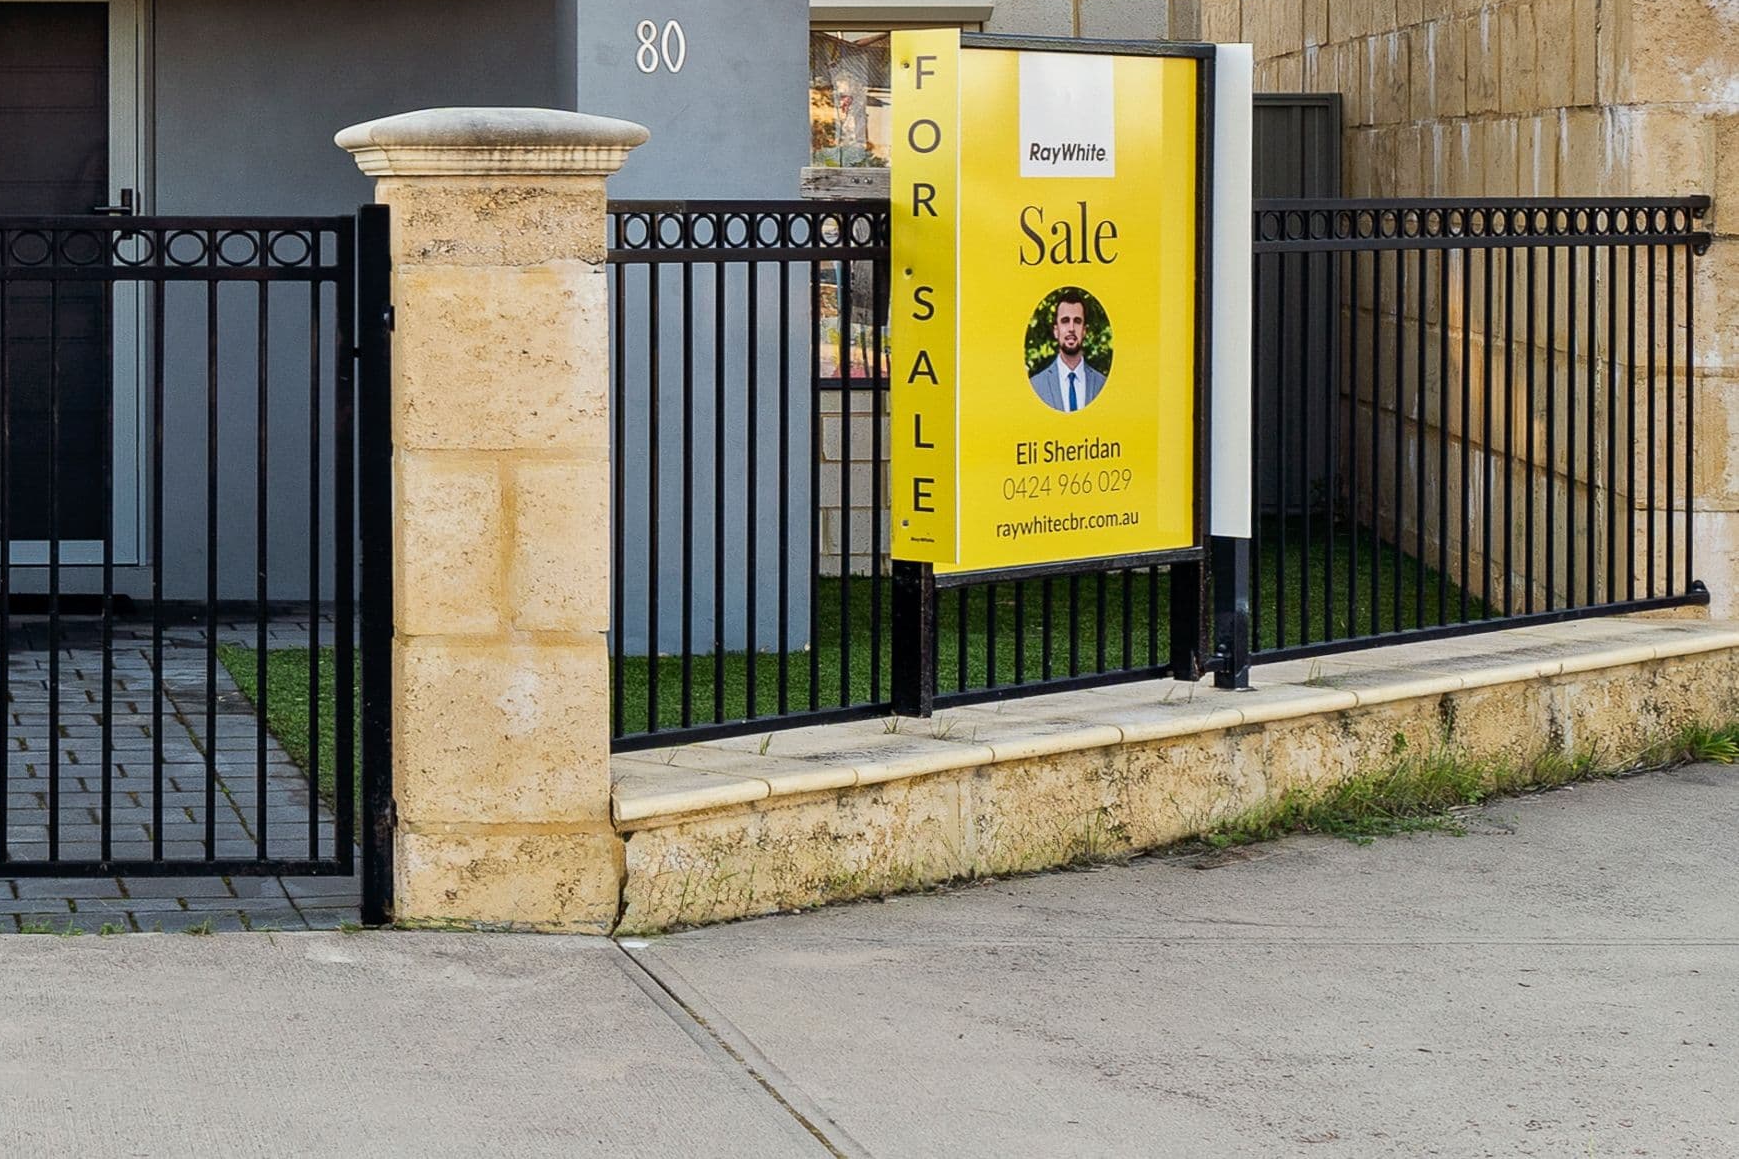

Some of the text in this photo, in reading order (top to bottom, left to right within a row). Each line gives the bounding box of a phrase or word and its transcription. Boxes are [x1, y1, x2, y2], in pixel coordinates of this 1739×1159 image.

[636, 20, 686, 73] 80
[908, 55, 942, 218] FOR
[1019, 201, 1119, 266] Sale
[907, 285, 940, 514] SALE
[1016, 437, 1121, 465] Eli Sheridan
[1003, 468, 1133, 500] 0424 966 029
[996, 511, 1139, 540] raywhitecbr.com.au
